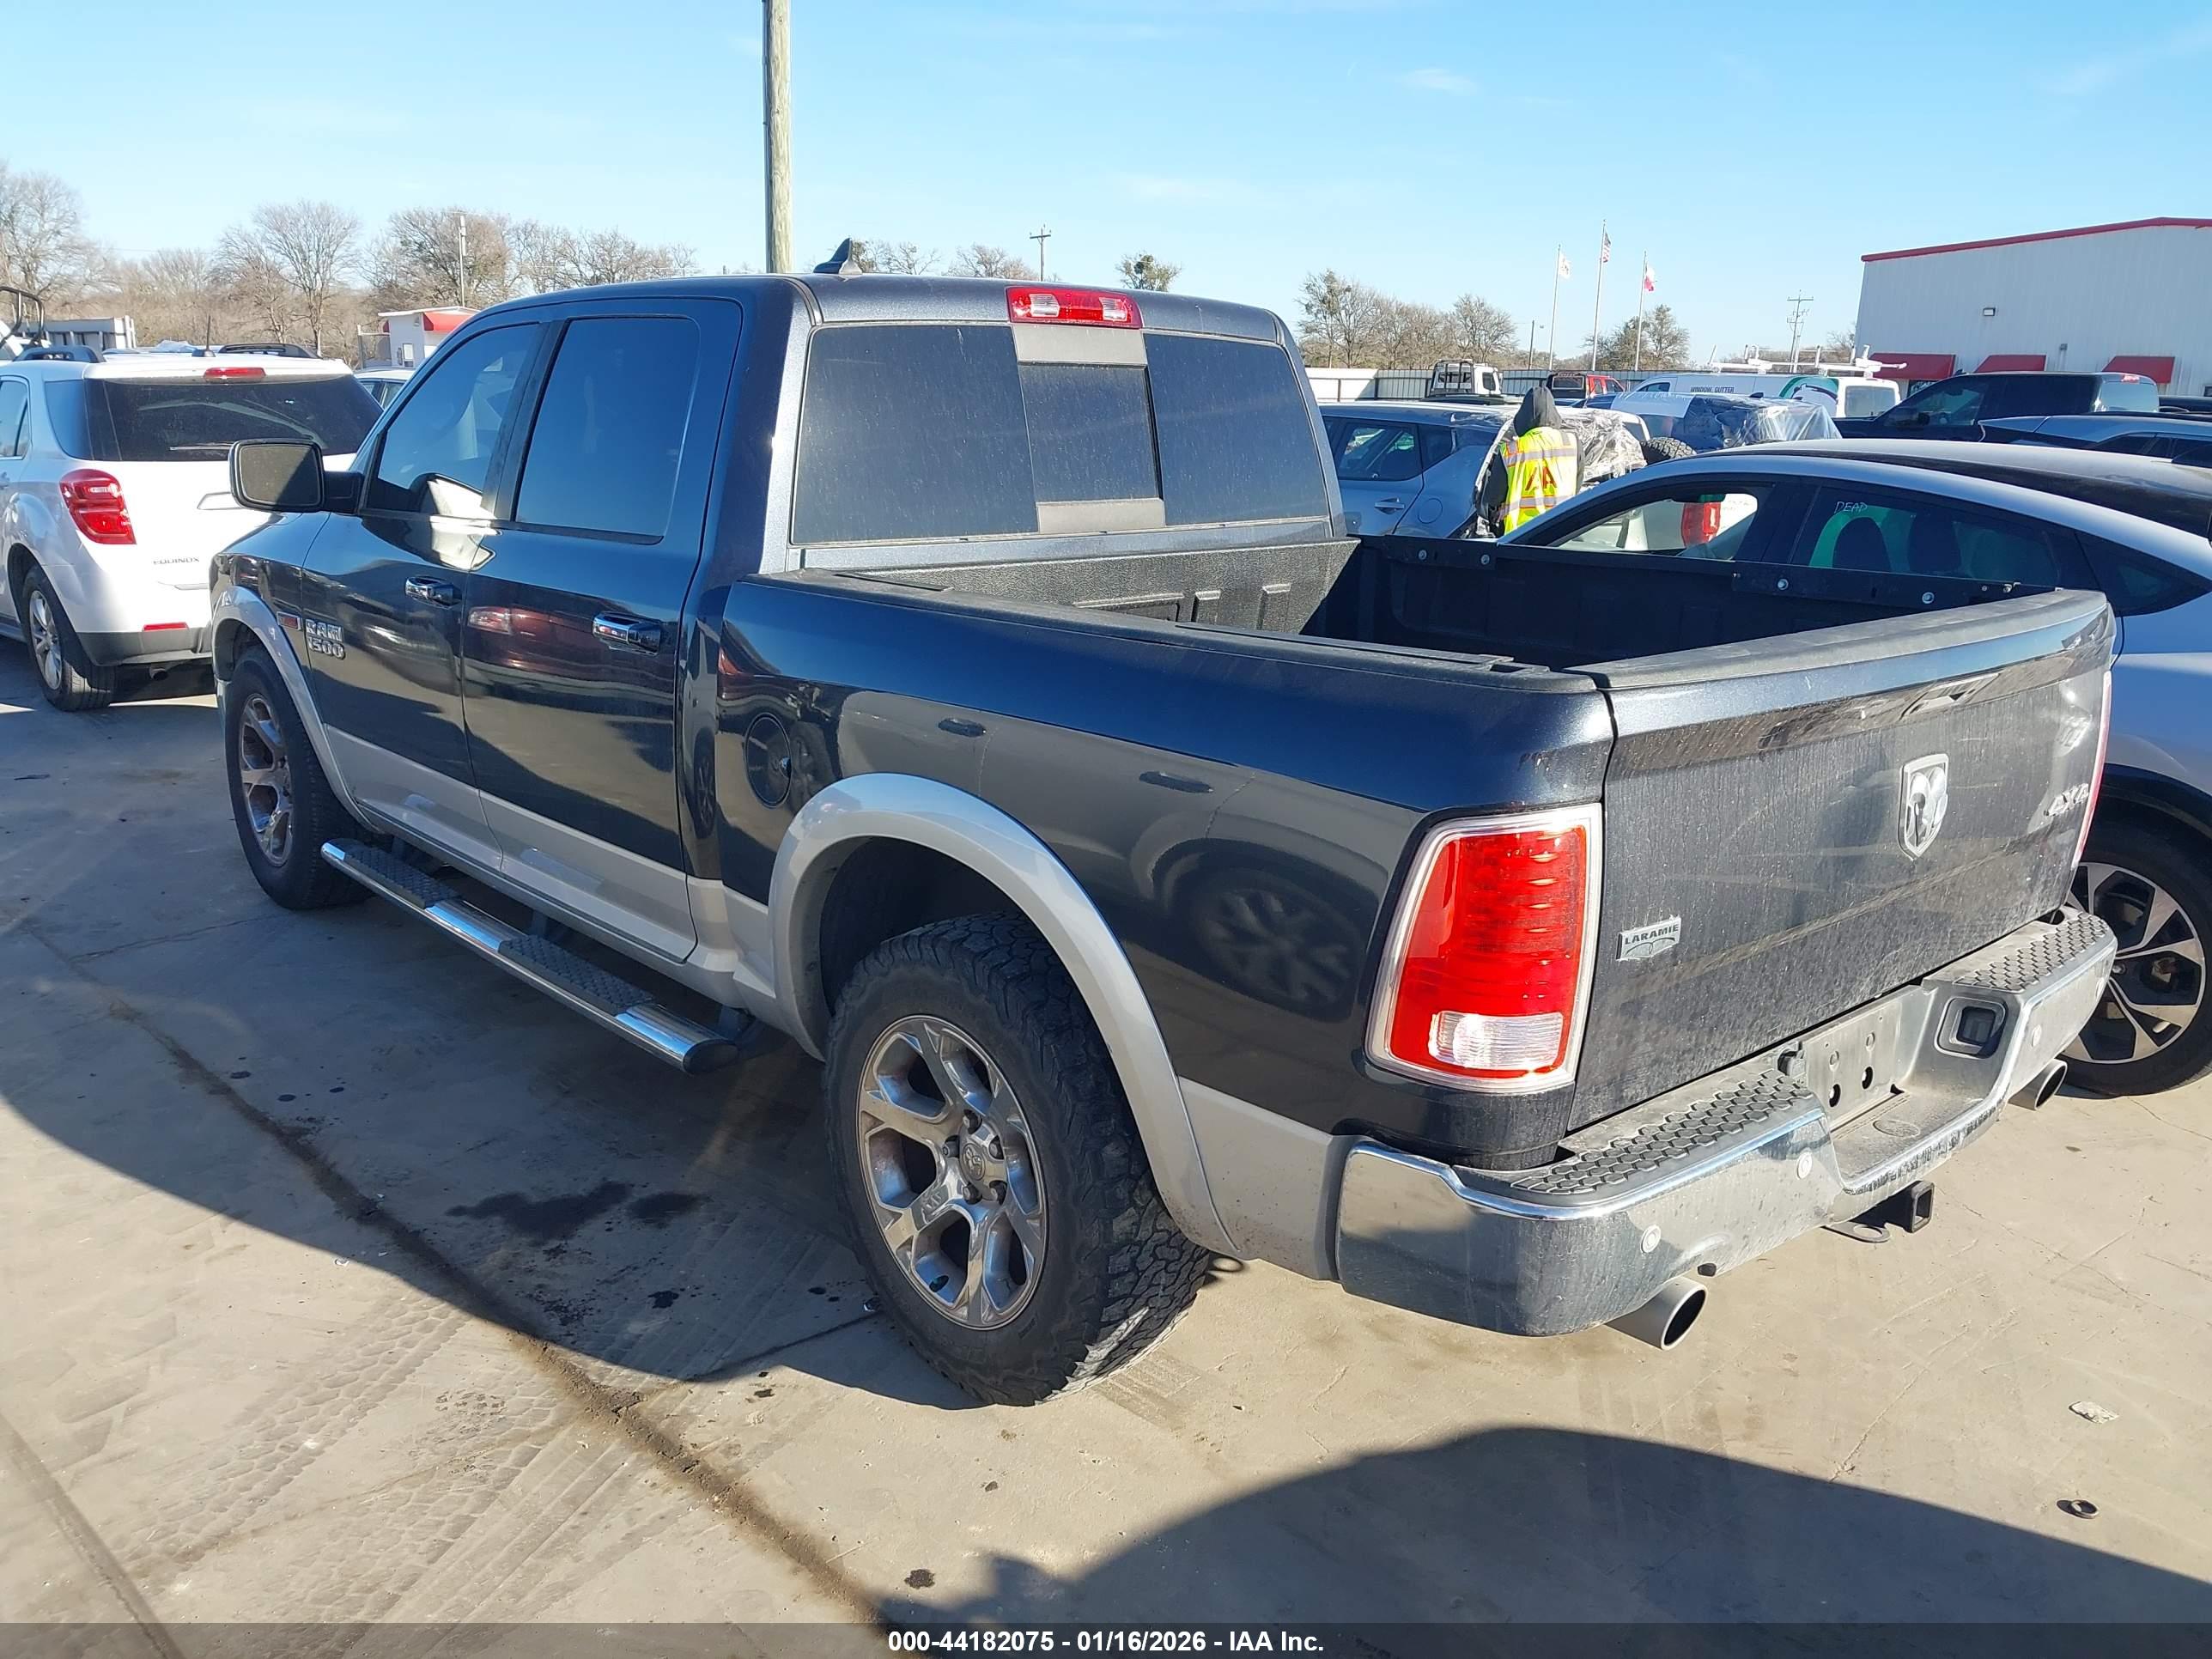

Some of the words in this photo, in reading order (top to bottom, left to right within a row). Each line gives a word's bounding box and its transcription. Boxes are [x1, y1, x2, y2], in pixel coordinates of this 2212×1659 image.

[1833, 501, 1868, 514] DEAD
[305, 618, 343, 641] RAM
[307, 636, 345, 659] 1500
[1624, 923, 1679, 945] LARAMIE
